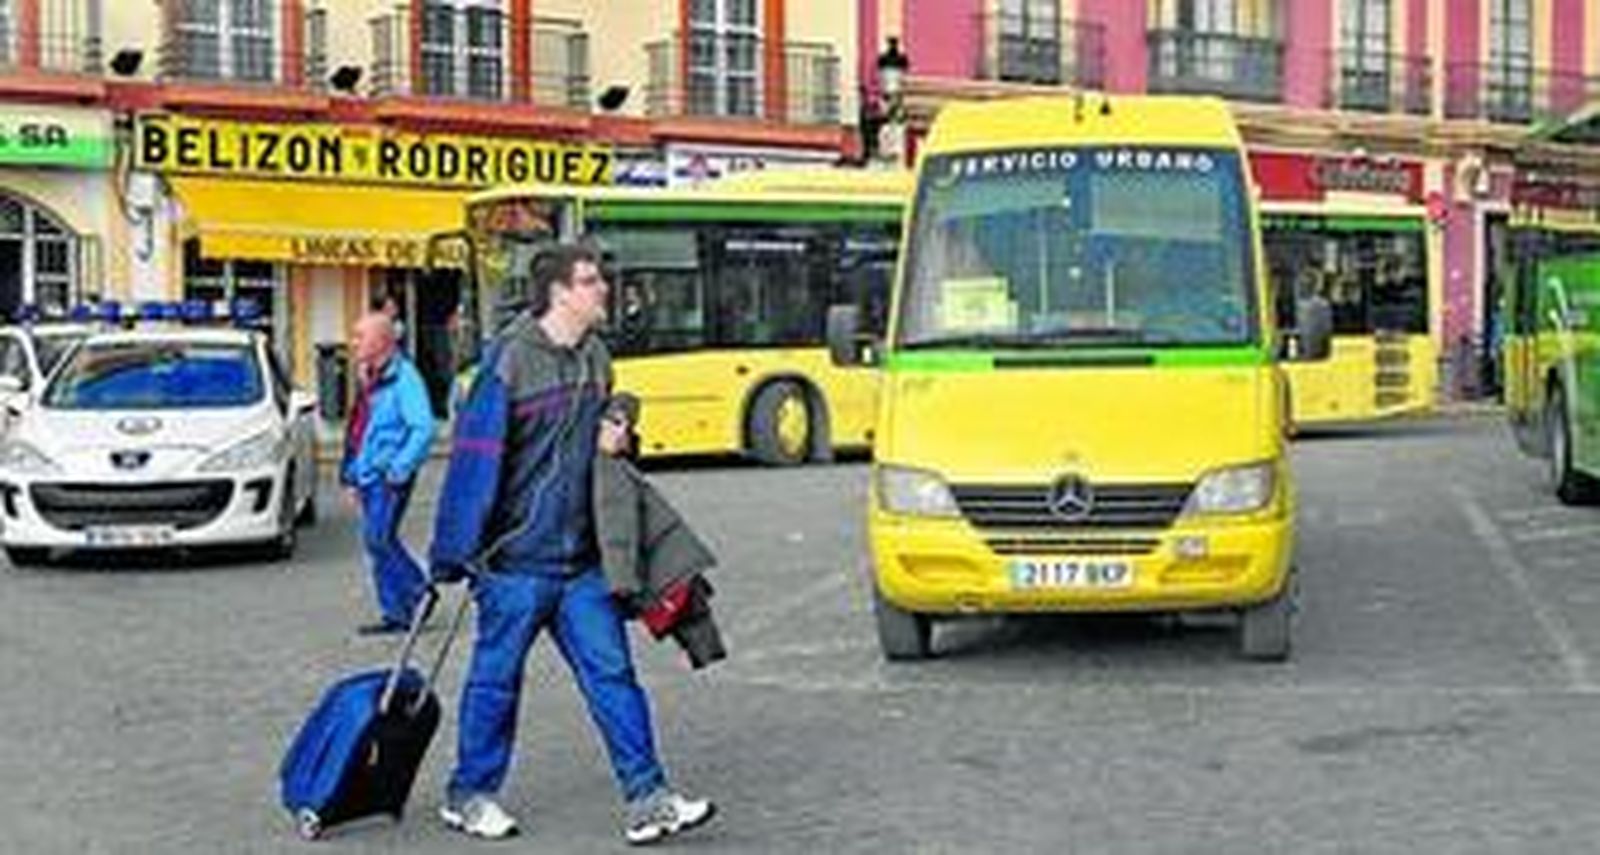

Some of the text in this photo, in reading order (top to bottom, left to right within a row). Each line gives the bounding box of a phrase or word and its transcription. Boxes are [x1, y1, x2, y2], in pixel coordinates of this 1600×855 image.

[142, 124, 342, 175] BELIZON
[378, 140, 611, 185] RODRIGUEZ
[949, 150, 1214, 177] SERVICIO URBANO
[1023, 562, 1079, 585] 2117
